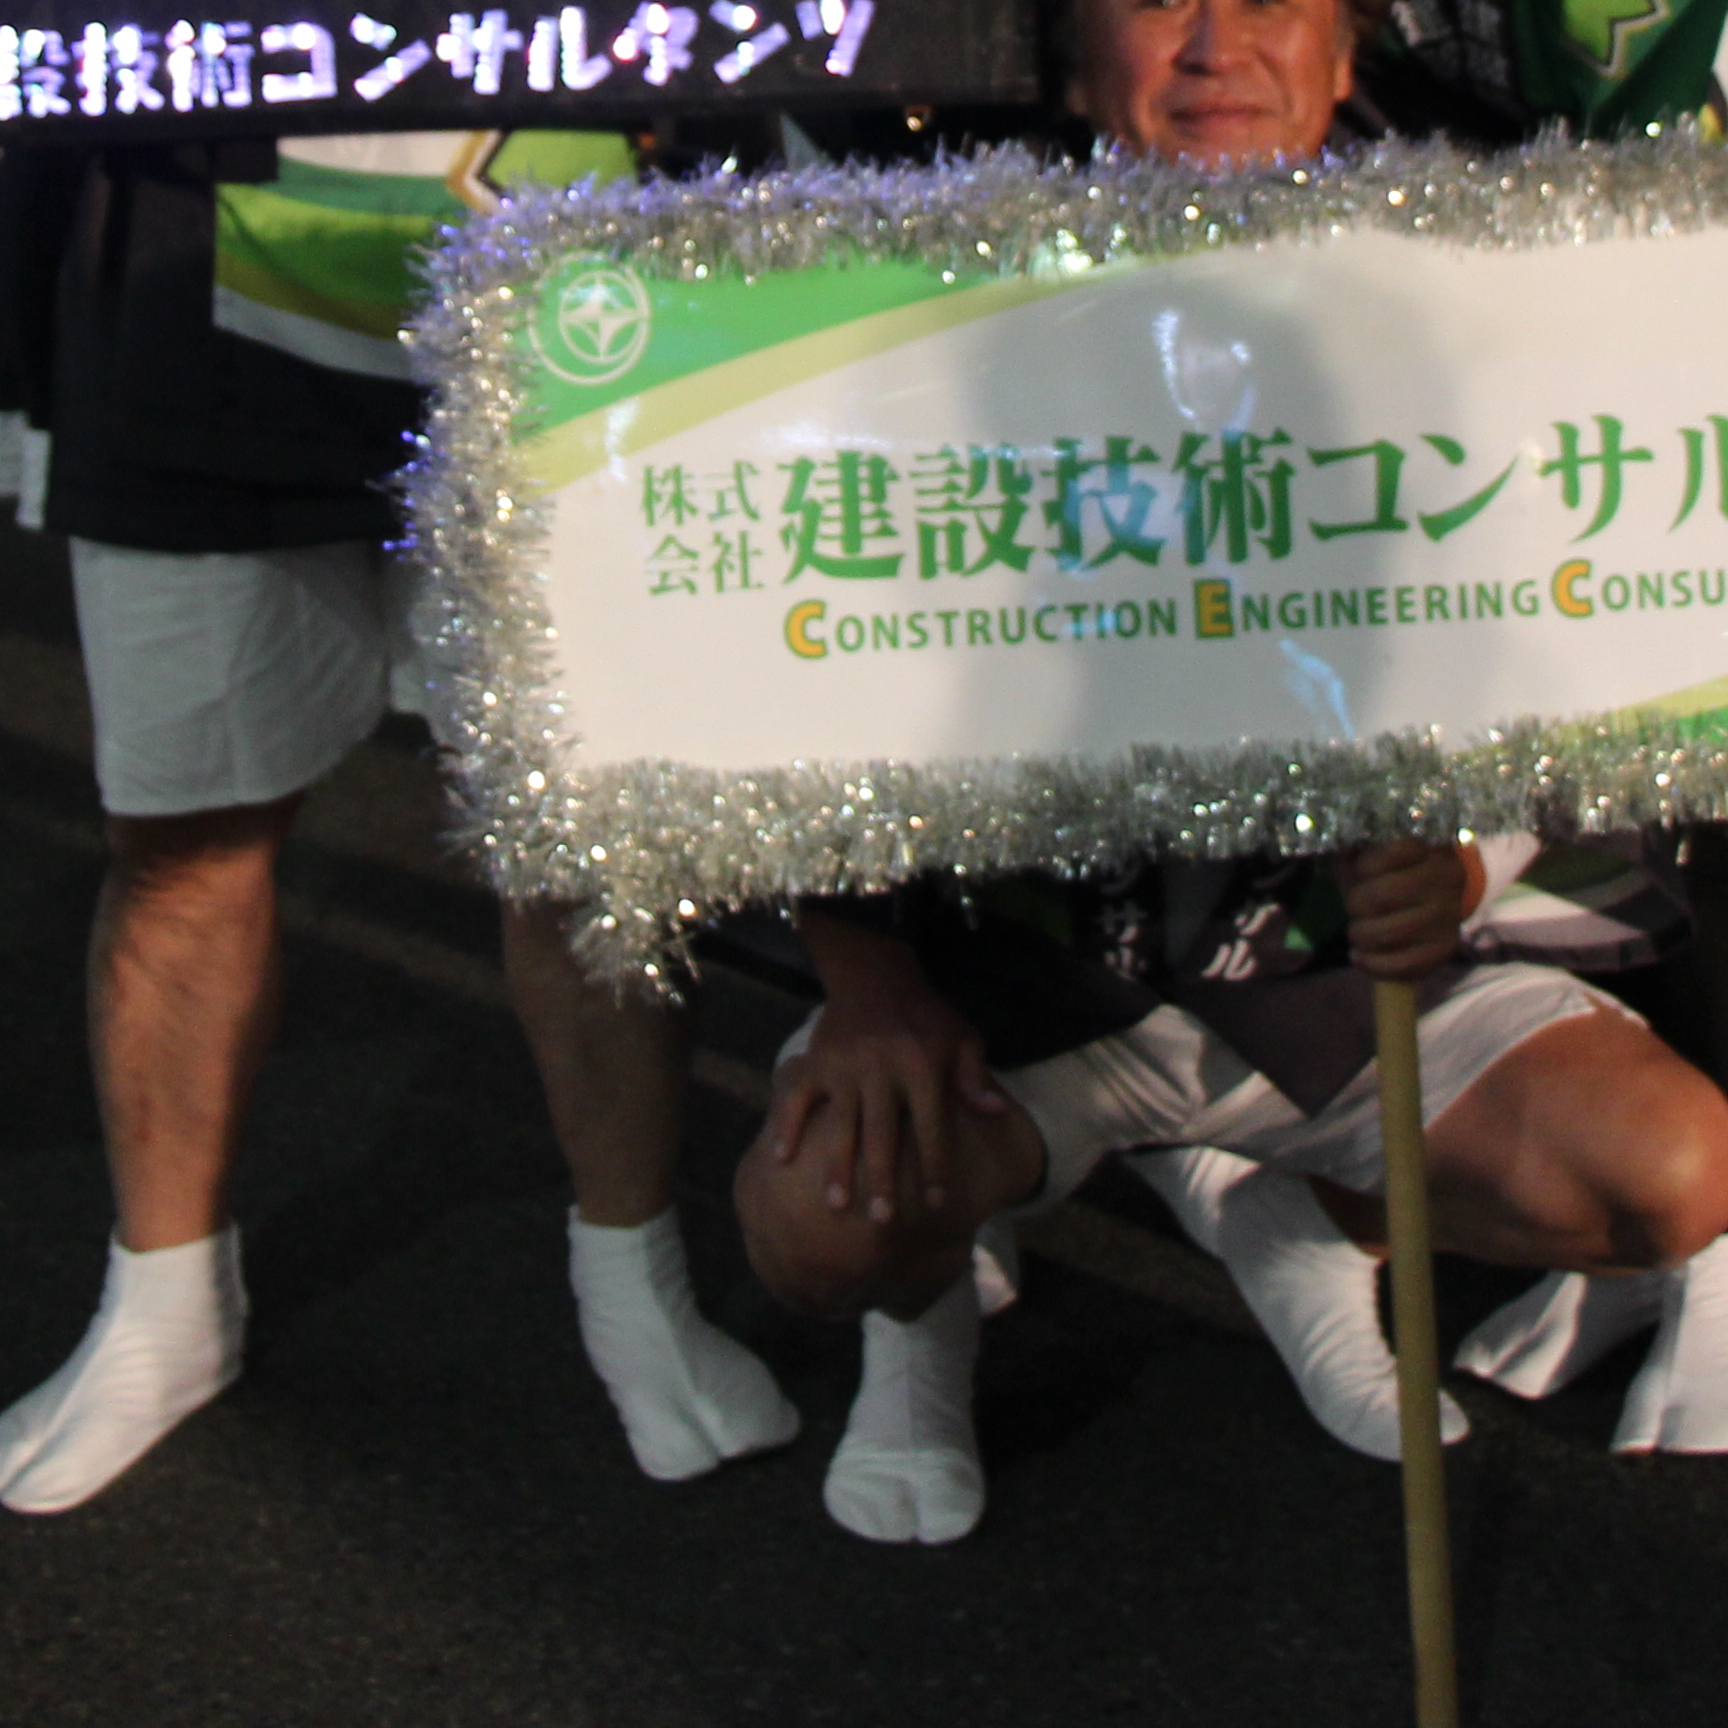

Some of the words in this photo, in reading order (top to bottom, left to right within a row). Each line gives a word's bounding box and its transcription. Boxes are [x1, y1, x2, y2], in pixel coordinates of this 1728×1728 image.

[641, 461, 760, 530] 株式
[642, 530, 764, 598] 会社
[784, 596, 1179, 661] CONSTRUCTION
[1193, 575, 1540, 641] ENGINEERING
